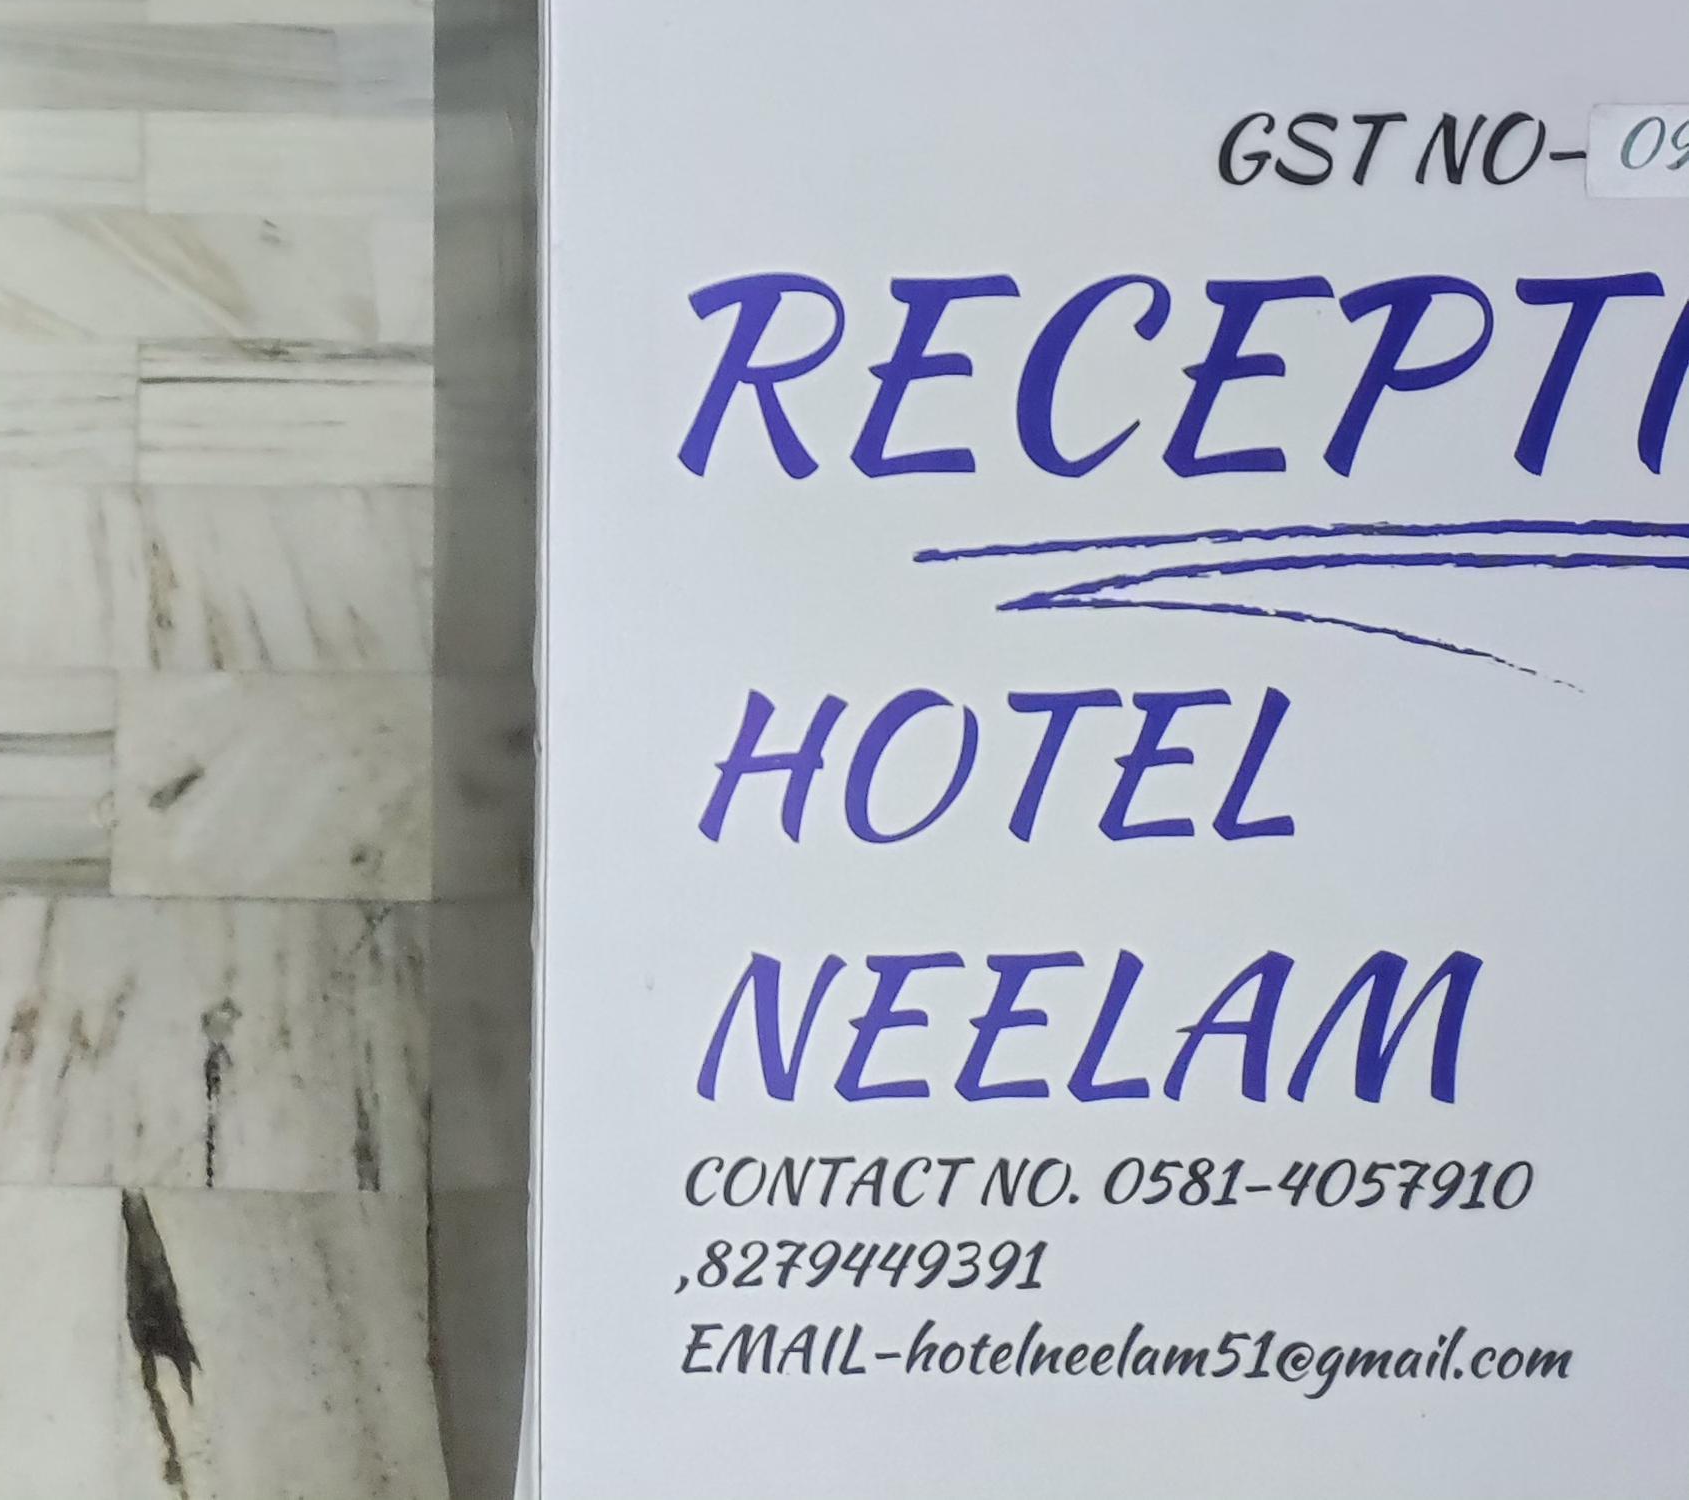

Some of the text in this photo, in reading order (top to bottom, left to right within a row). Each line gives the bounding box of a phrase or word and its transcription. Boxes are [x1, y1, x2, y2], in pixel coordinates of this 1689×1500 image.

[1218, 111, 1407, 186] GST
[1414, 111, 1587, 186] NO-
[698, 686, 1295, 843] HOTEL
[697, 949, 1484, 1105] NEELAM
[685, 1156, 1534, 1211] CONTACT NO. 0581-4057910
[674, 1239, 1048, 1293] ,8279449391
[681, 1320, 1573, 1400] EMAIL-hotelneelam51@gmail.com
